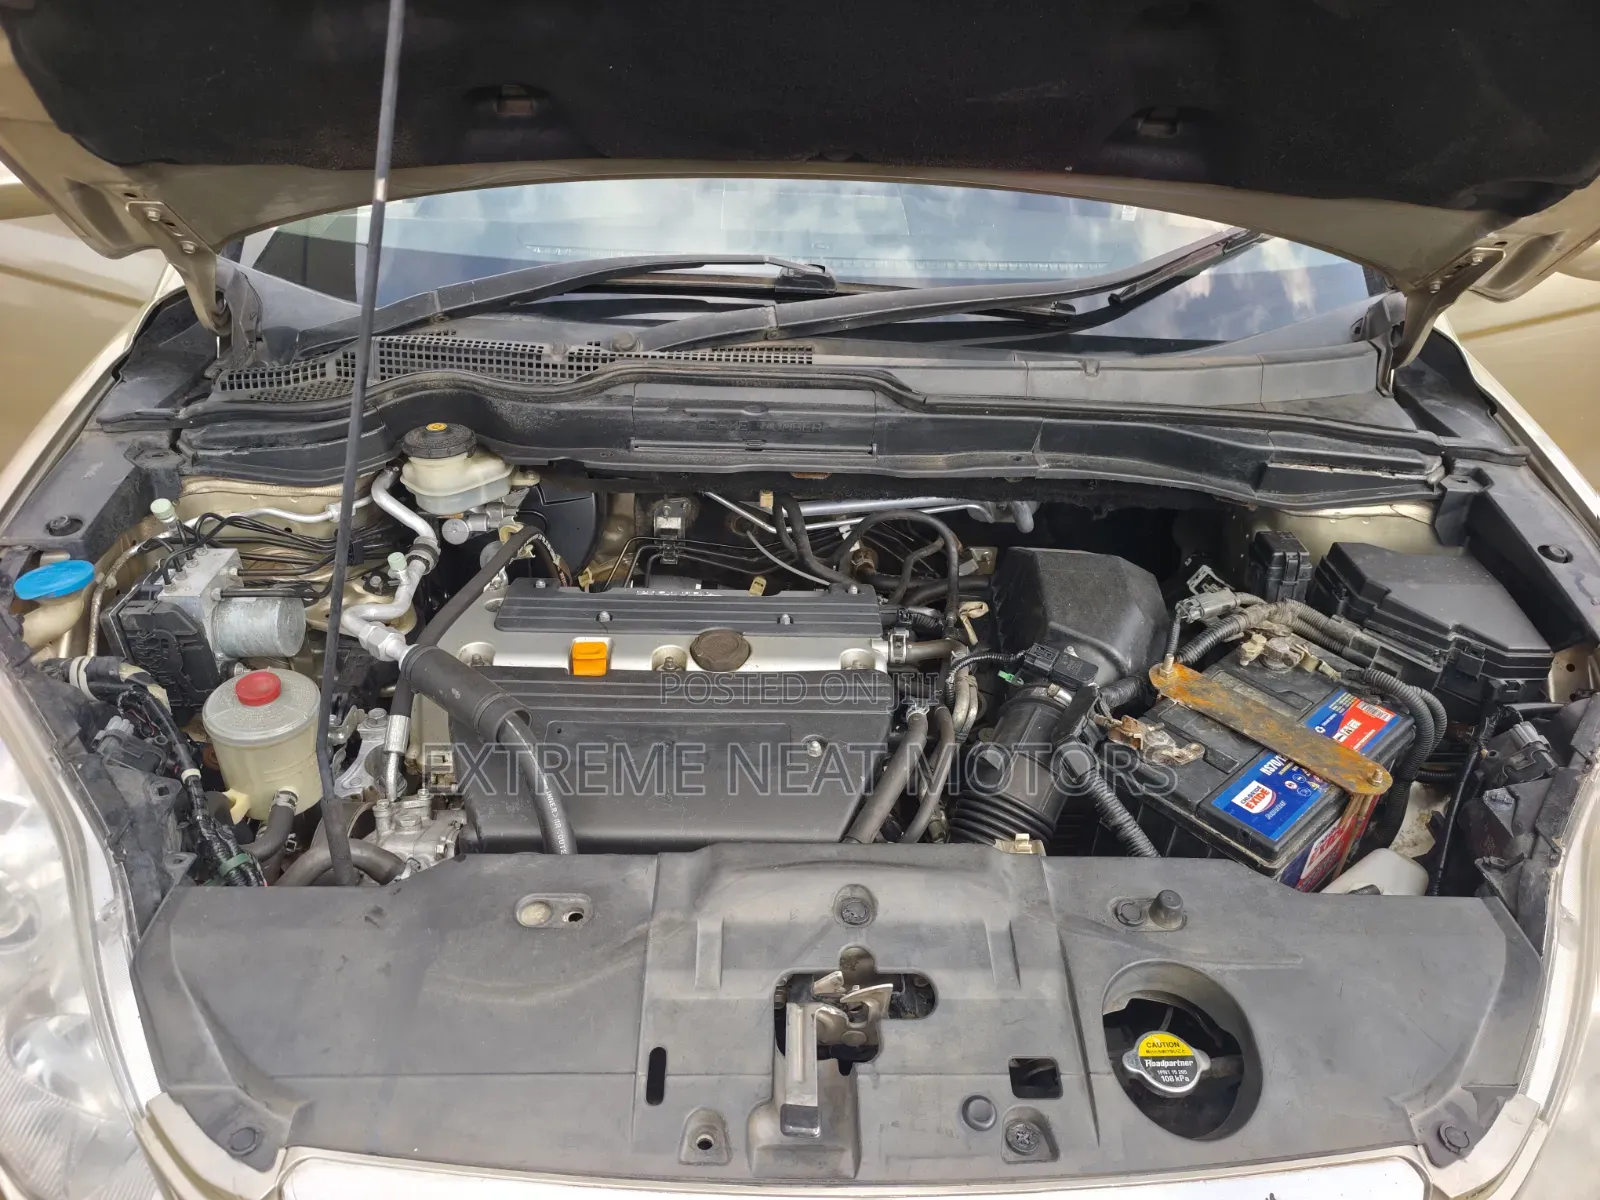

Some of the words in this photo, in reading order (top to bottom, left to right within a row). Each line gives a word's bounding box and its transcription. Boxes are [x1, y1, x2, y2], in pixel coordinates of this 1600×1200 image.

[1245, 787, 1271, 810] EXIDE
[1146, 1041, 1181, 1049] CAUTION
[1144, 1059, 1194, 1068] Roadpartner
